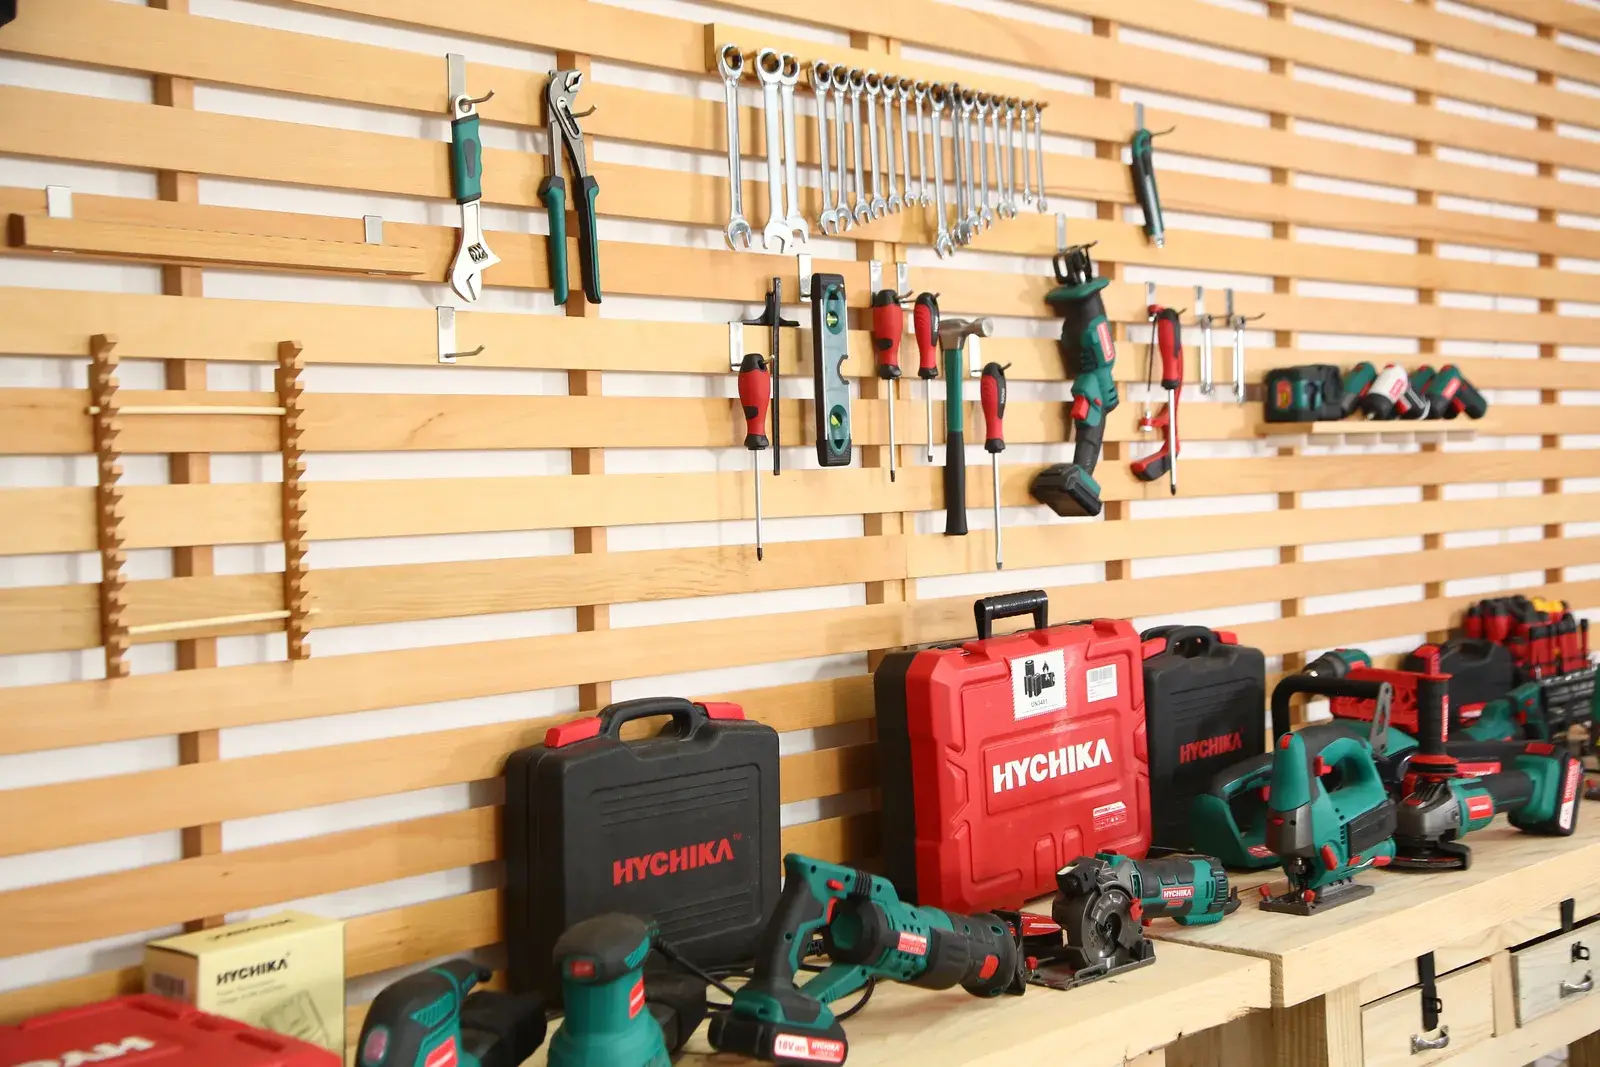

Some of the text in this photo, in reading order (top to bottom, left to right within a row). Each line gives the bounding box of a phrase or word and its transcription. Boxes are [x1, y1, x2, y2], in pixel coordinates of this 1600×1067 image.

[1180, 732, 1242, 764] HYCHIKA
[993, 738, 1112, 793] HYCHIKA
[612, 837, 734, 887] HYCHIKA
[1163, 888, 1192, 898] HYCHIKA
[216, 957, 288, 987] HYCHIKA
